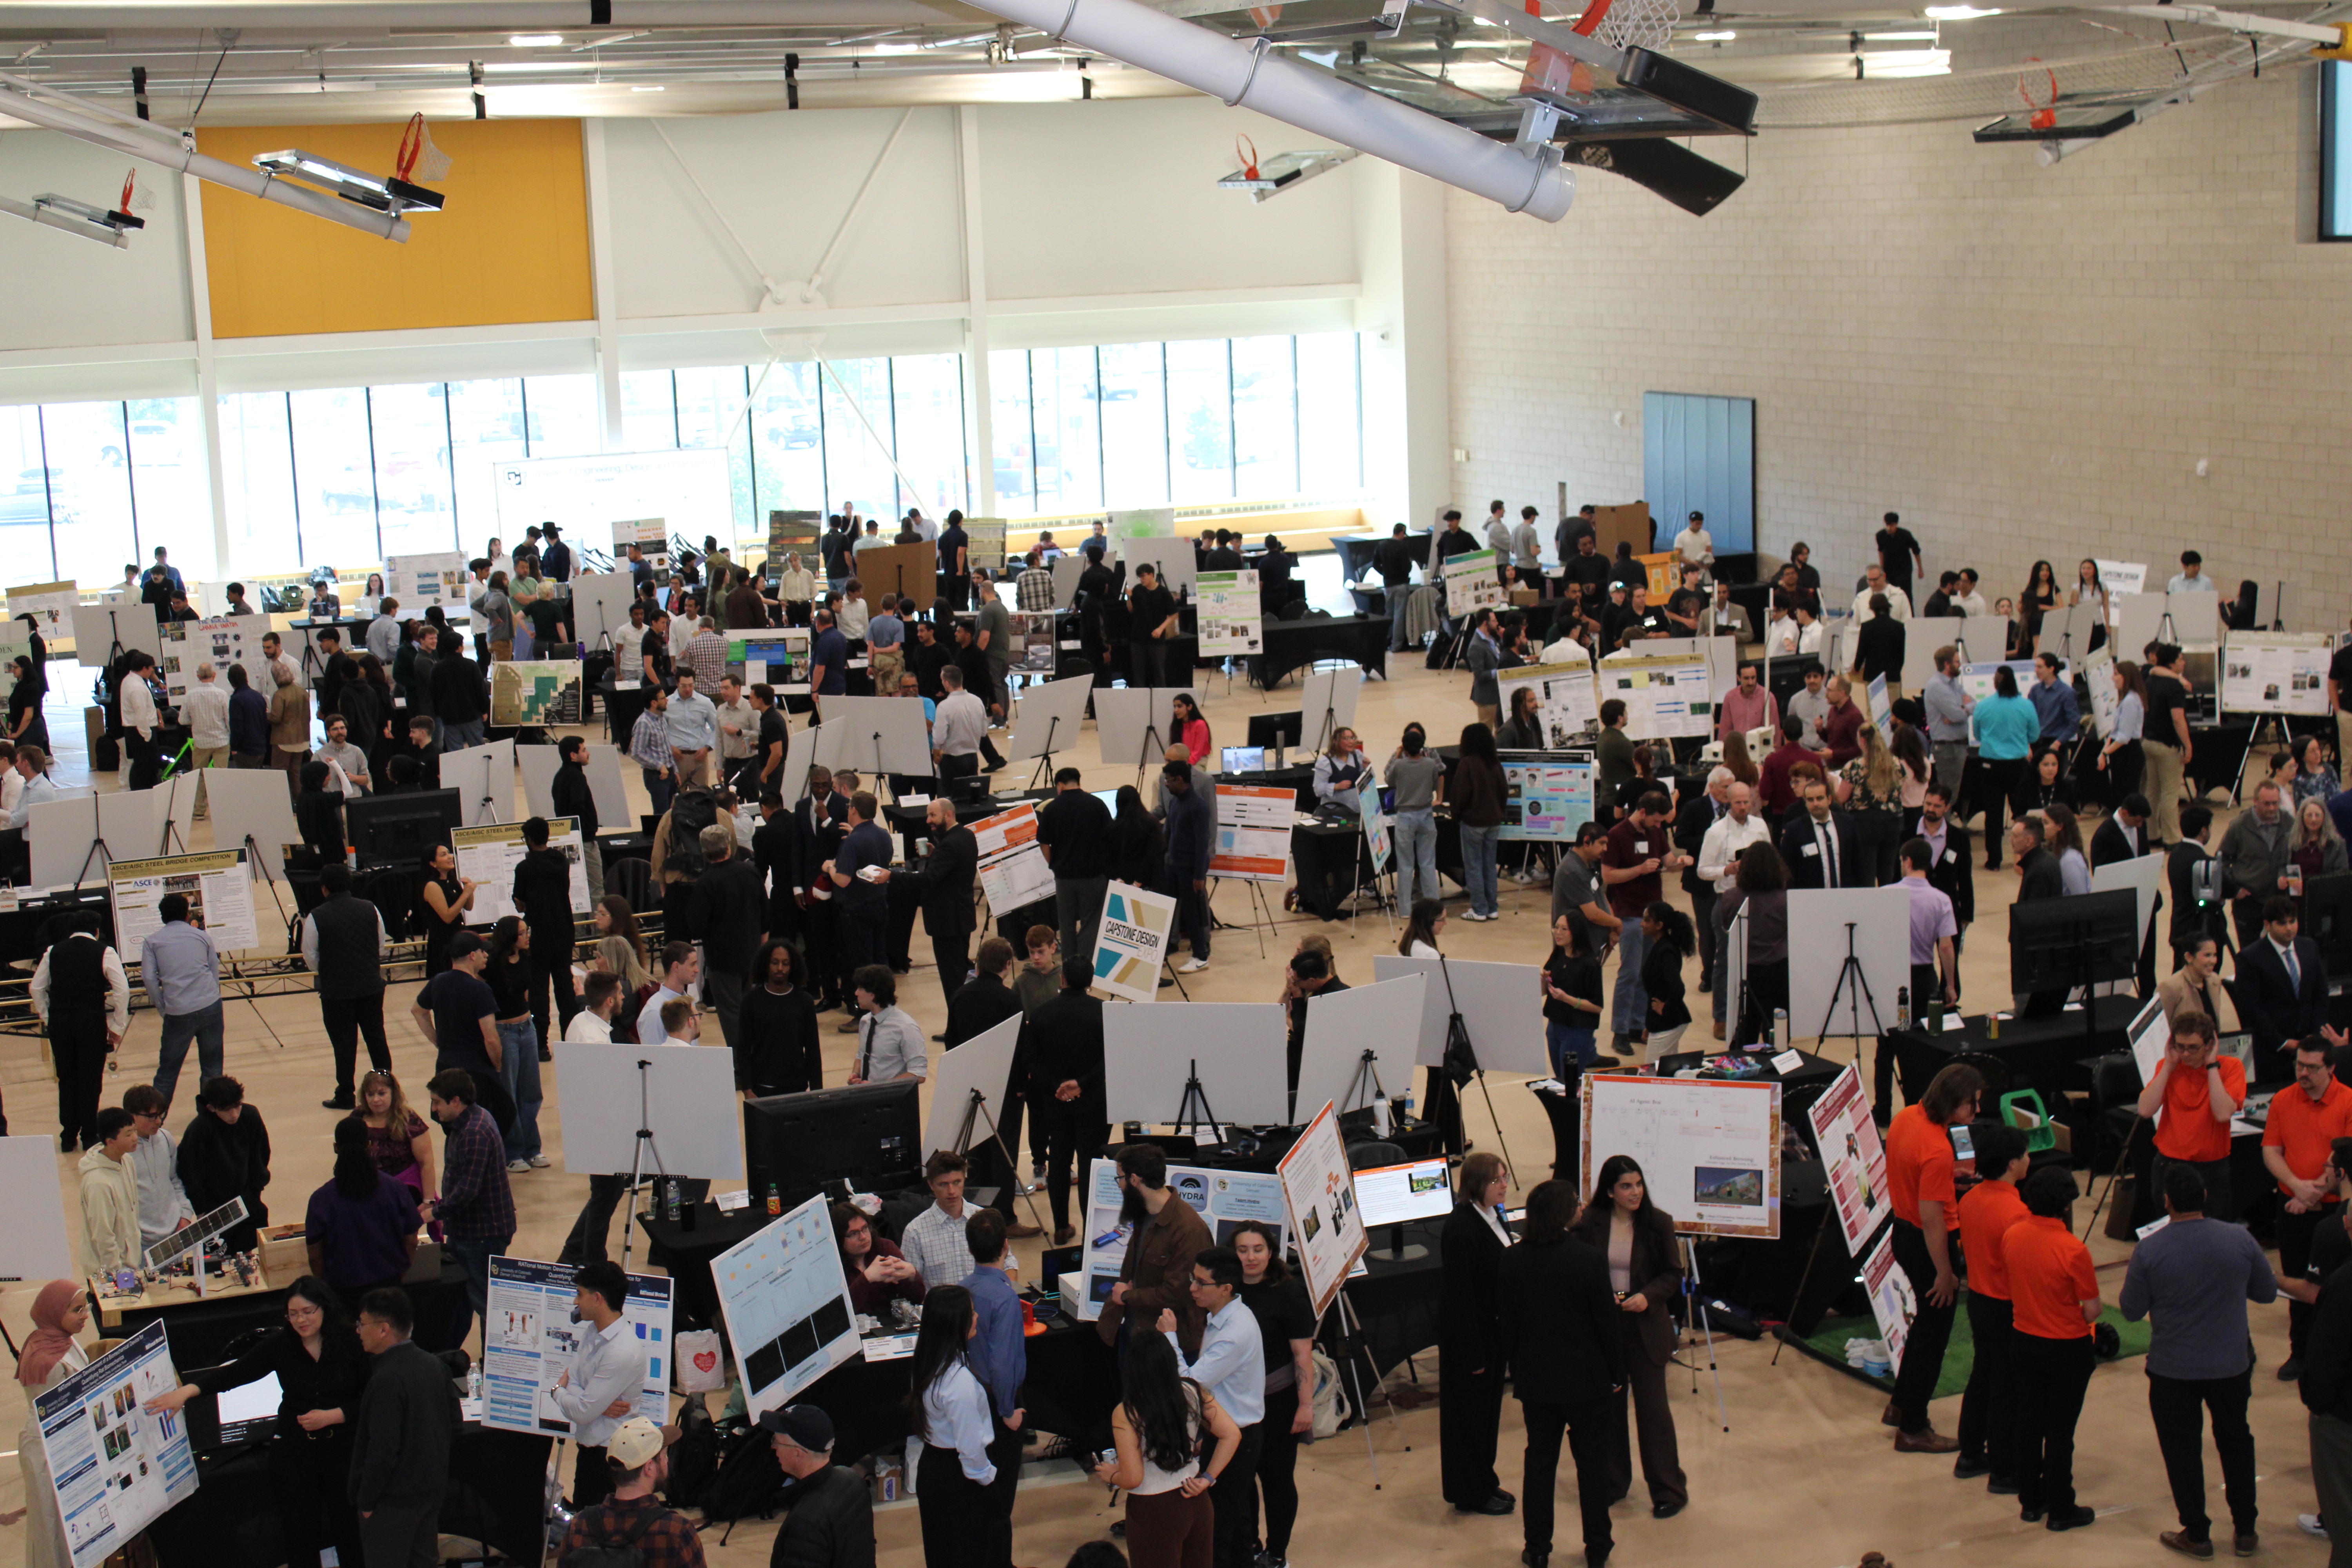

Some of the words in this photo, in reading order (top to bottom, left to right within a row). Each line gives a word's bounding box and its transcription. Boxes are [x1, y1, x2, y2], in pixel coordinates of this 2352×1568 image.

[574, 465, 623, 475] Engineering,
[625, 463, 652, 473] Design
[111, 862, 143, 871] ASCE/AISC
[190, 854, 231, 862] COMPETITION
[1105, 921, 1136, 942] CAPSTONE
[1136, 931, 1160, 948] DESIGN
[1138, 945, 1158, 962] EXPO
[548, 1272, 572, 1281] Quantifying
